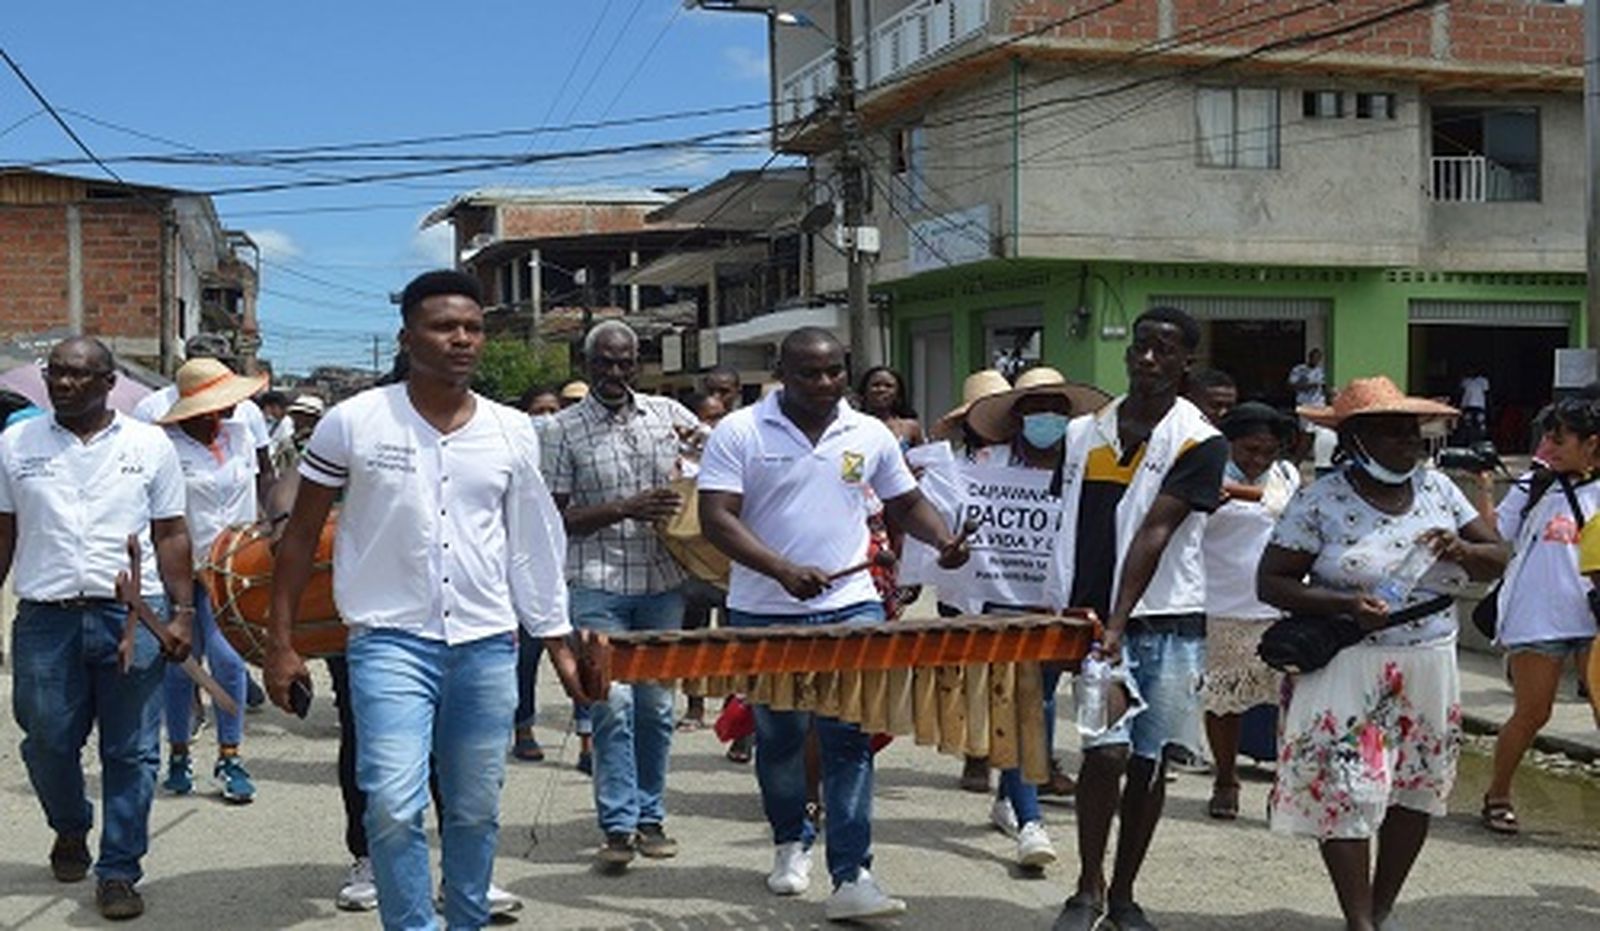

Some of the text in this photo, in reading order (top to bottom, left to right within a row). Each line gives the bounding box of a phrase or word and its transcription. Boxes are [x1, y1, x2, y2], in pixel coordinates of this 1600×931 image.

[966, 504, 1048, 532] PACTO
[988, 533, 1028, 548] VIDA
[1032, 536, 1044, 549] Y
